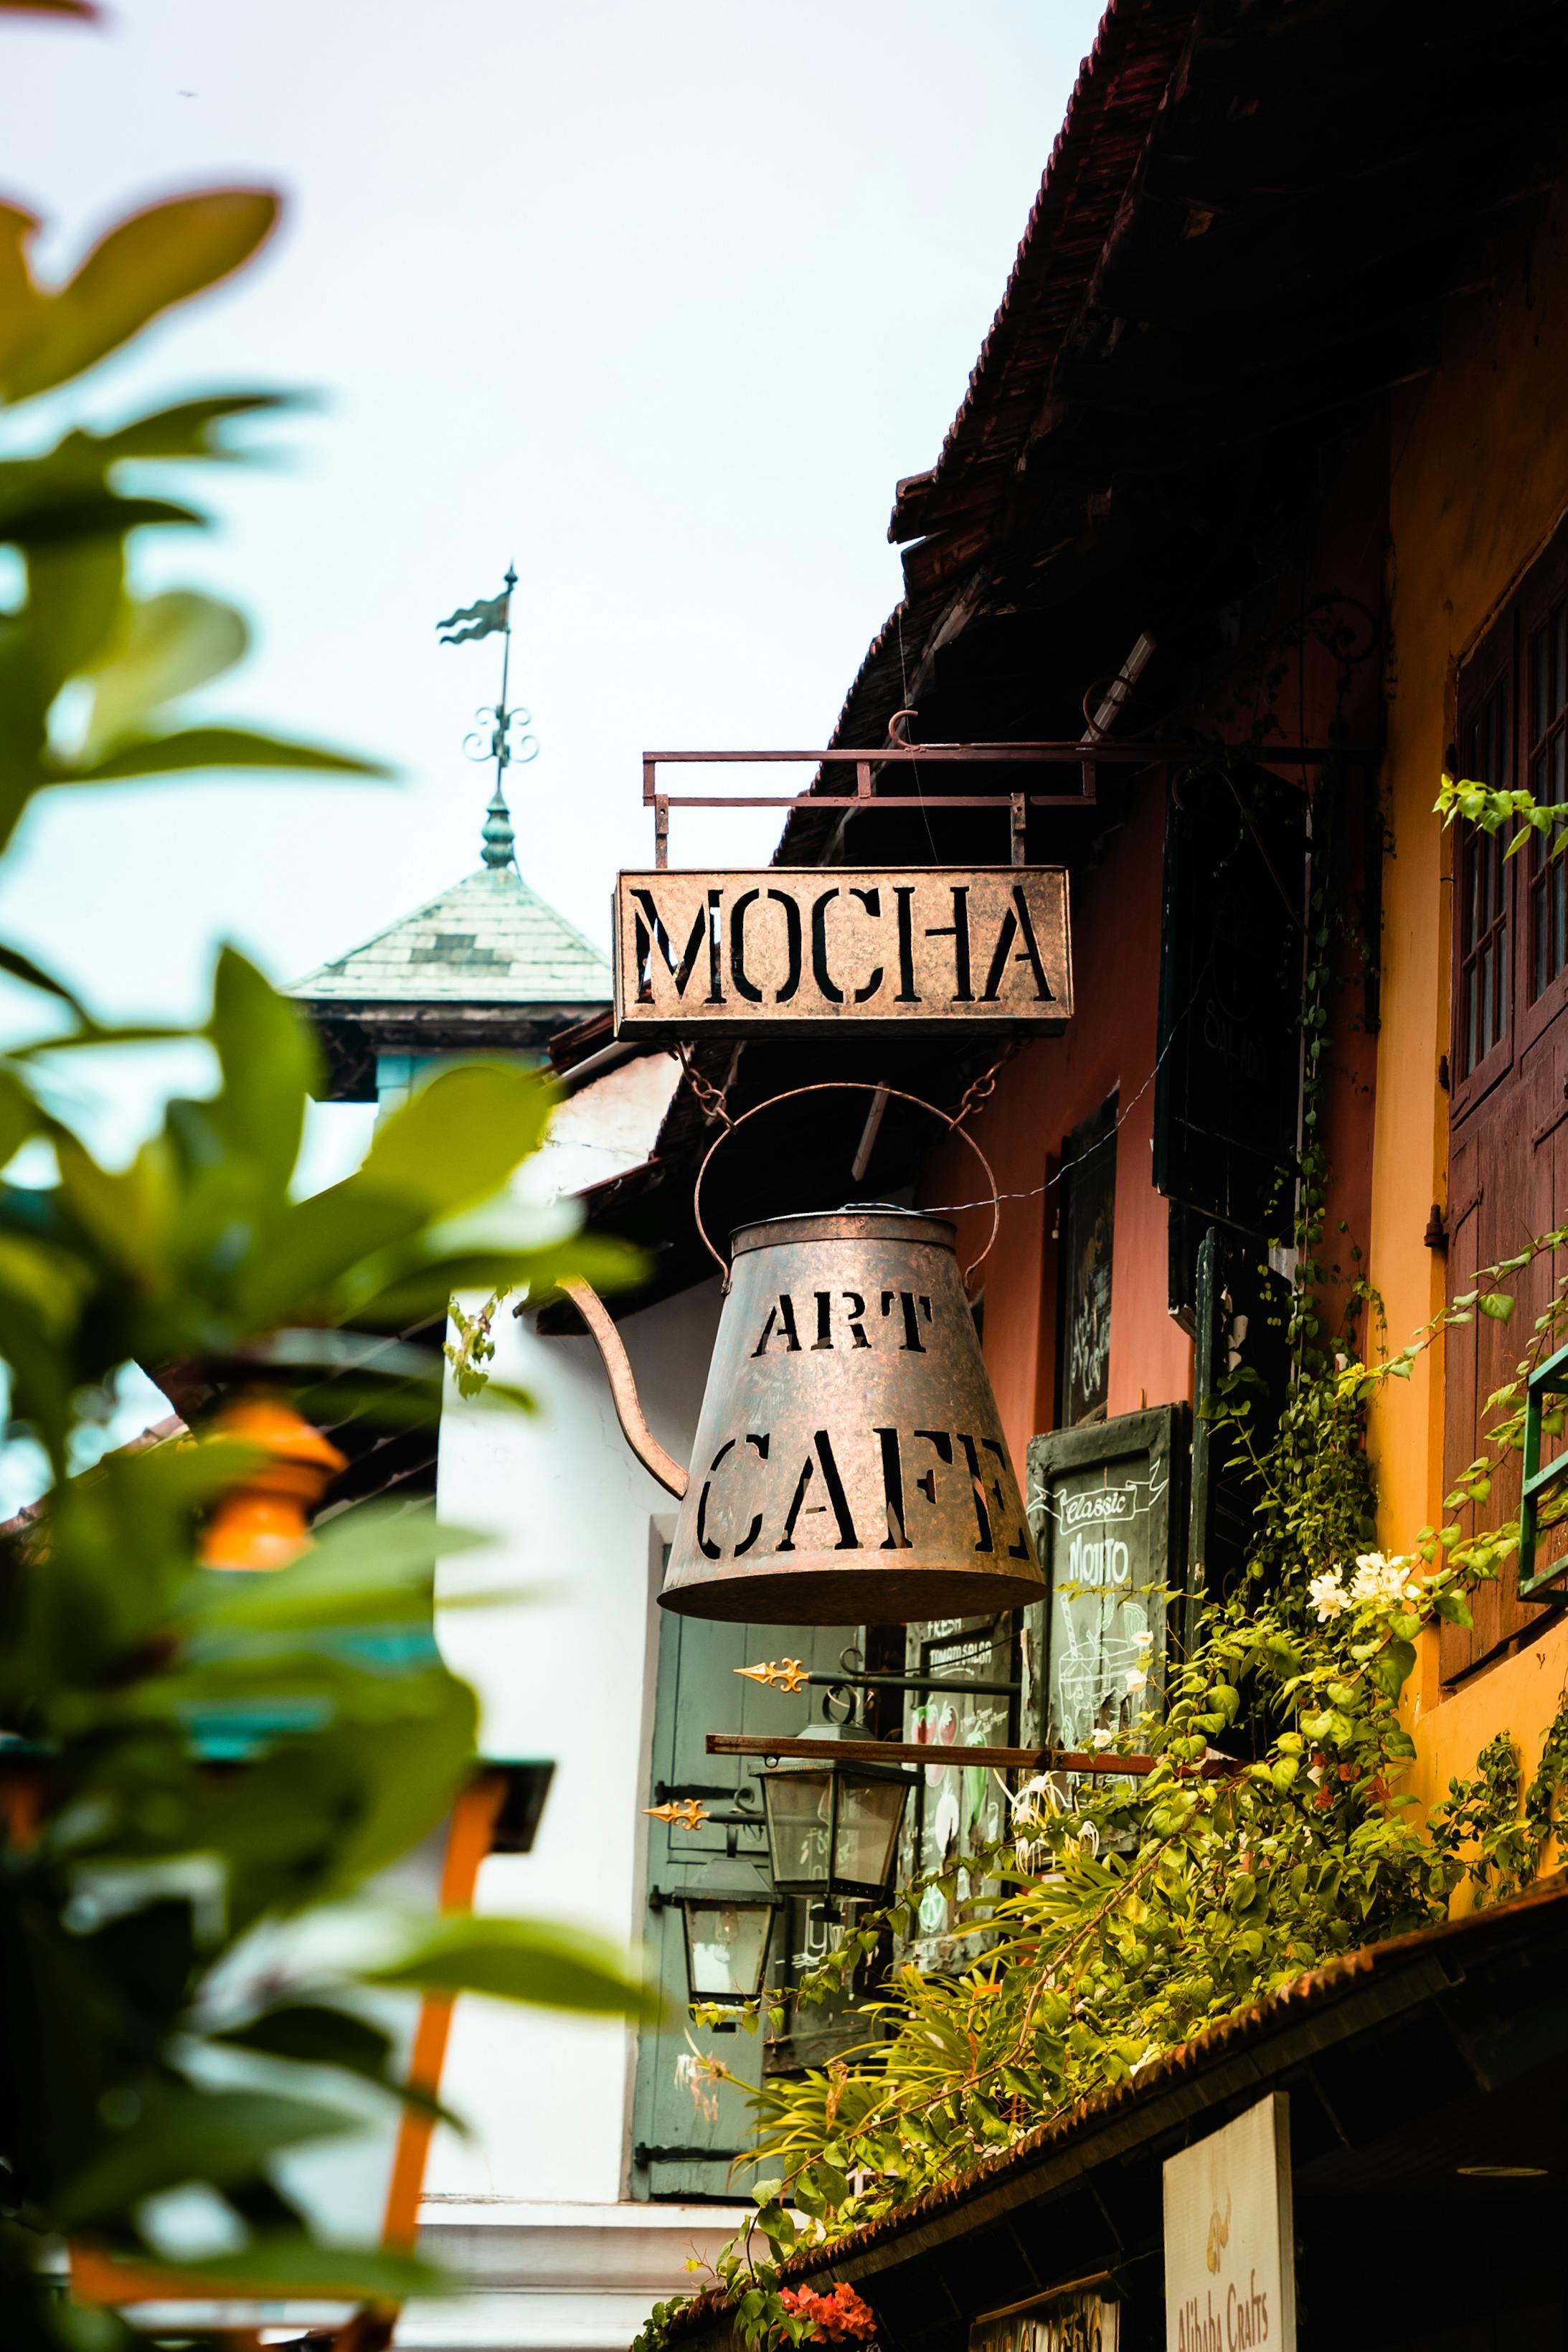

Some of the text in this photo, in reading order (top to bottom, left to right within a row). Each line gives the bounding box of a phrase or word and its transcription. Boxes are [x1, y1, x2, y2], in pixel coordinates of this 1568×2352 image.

[628, 885, 1057, 1004] MOCHA
[750, 1290, 932, 1359] ART
[696, 1427, 1030, 1561] CAFE
[1066, 1491, 1126, 1524] Classic
